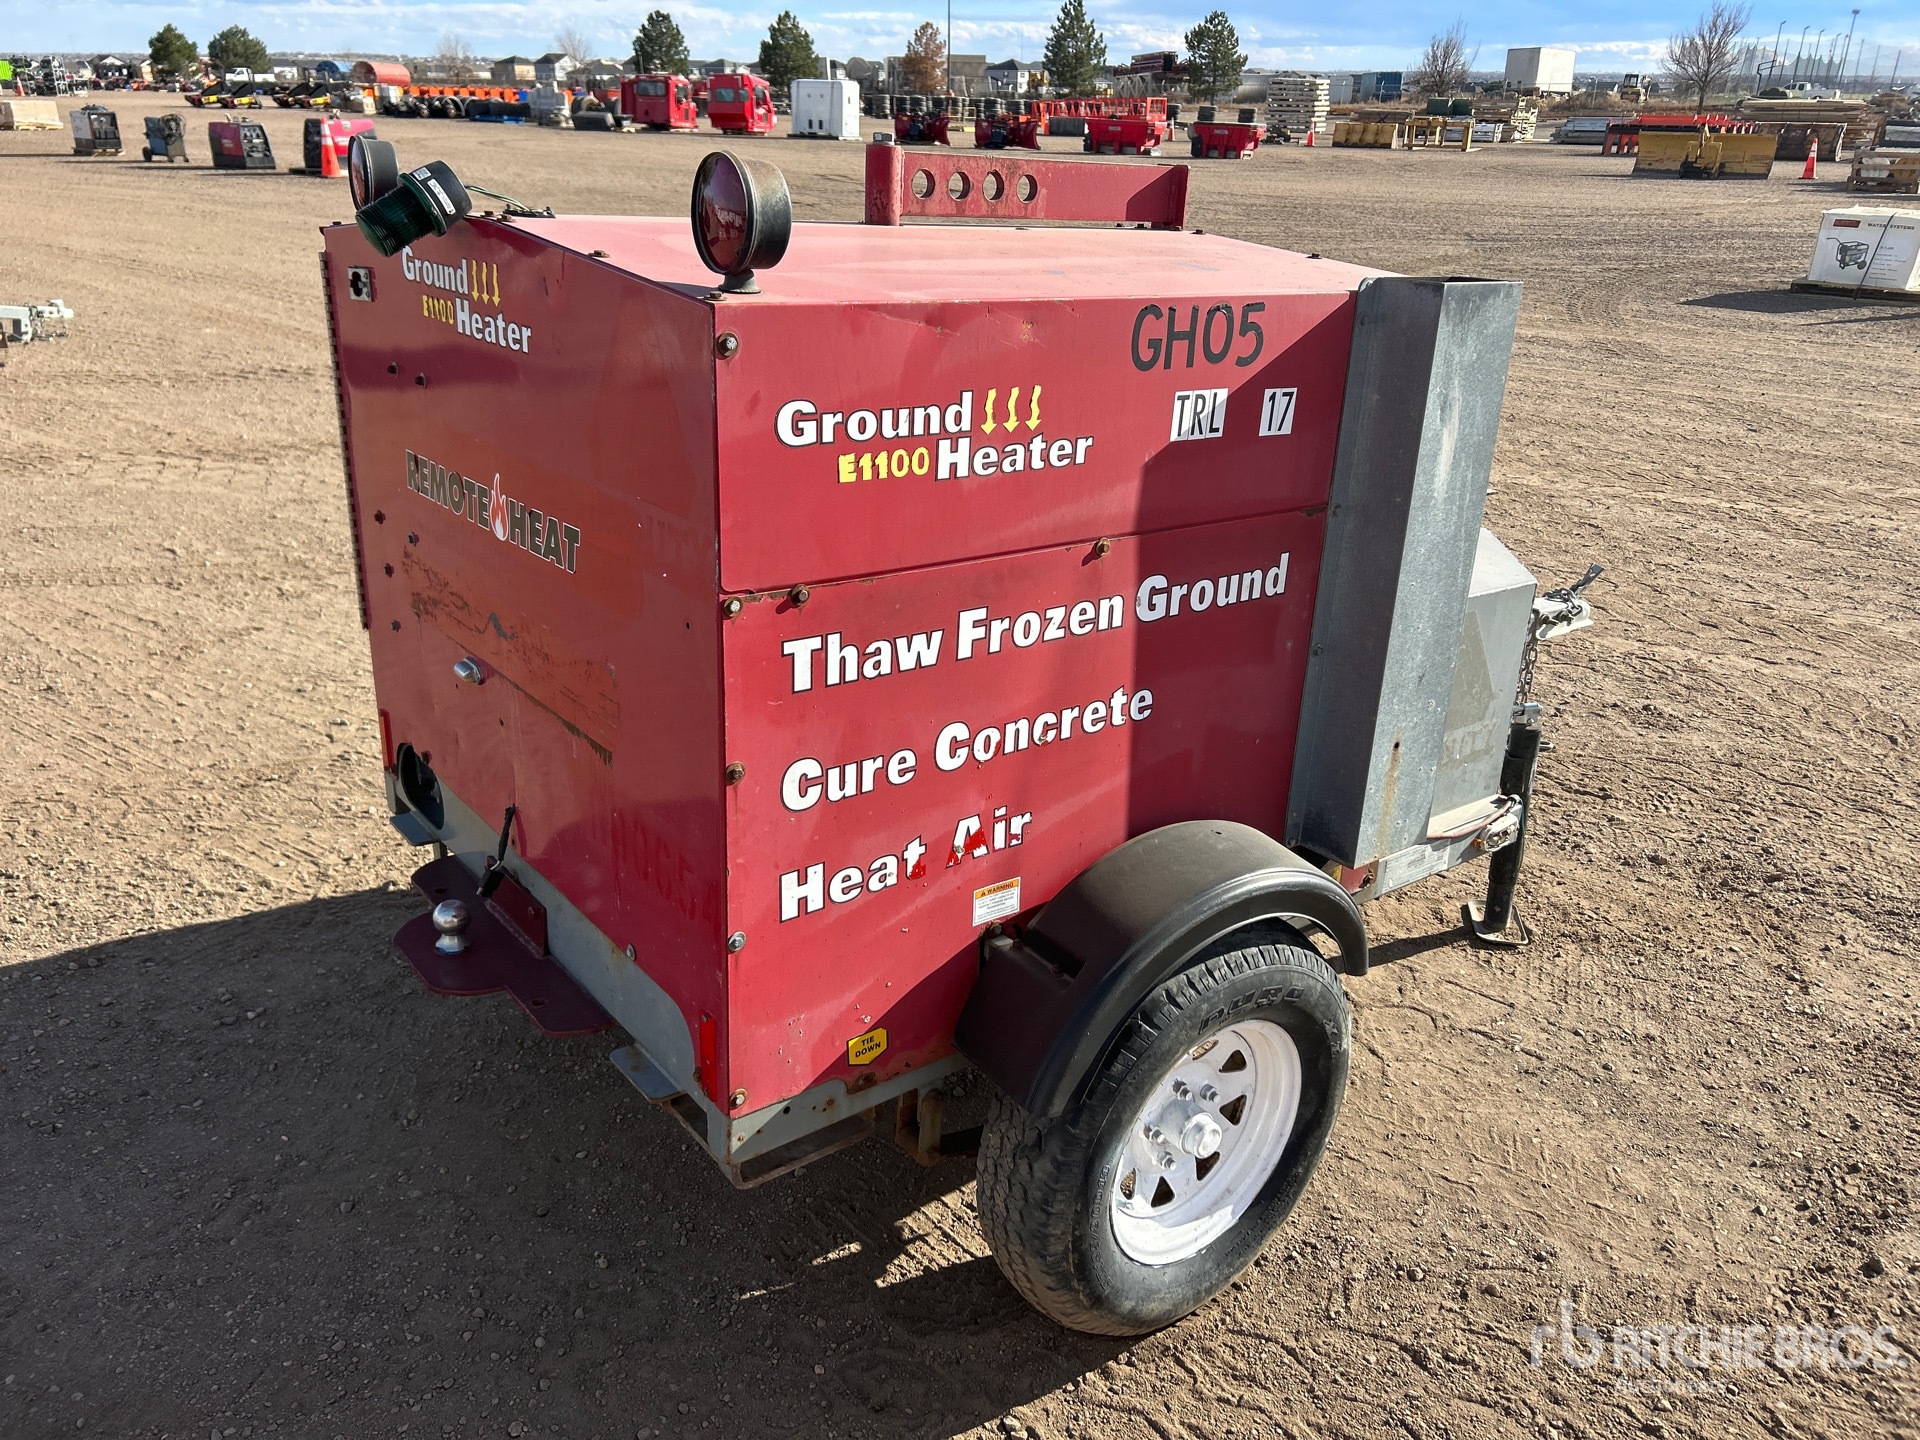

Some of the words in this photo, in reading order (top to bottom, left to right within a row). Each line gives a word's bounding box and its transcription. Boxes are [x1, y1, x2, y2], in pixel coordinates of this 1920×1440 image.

[401, 246, 468, 294] Ground
[422, 295, 455, 325] E1100
[455, 298, 532, 354] Heater
[775, 389, 973, 448] Ground
[1176, 392, 1222, 438] TRL
[1265, 390, 1292, 433] 17
[837, 446, 930, 484] E1100
[935, 433, 1094, 481] Heater
[405, 449, 492, 530] REMOTE
[508, 497, 581, 574] HEAT
[782, 627, 943, 694] Thaw
[956, 593, 1125, 661] Frozen
[1136, 552, 1289, 622] Ground
[781, 747, 917, 812] Cure
[934, 686, 1154, 773] Concrete
[779, 834, 927, 924] Heat
[946, 805, 1033, 869] Air
[987, 881, 1014, 894] WARNING
[855, 1042, 881, 1058] DOWN
[861, 1035, 875, 1046] TIE
